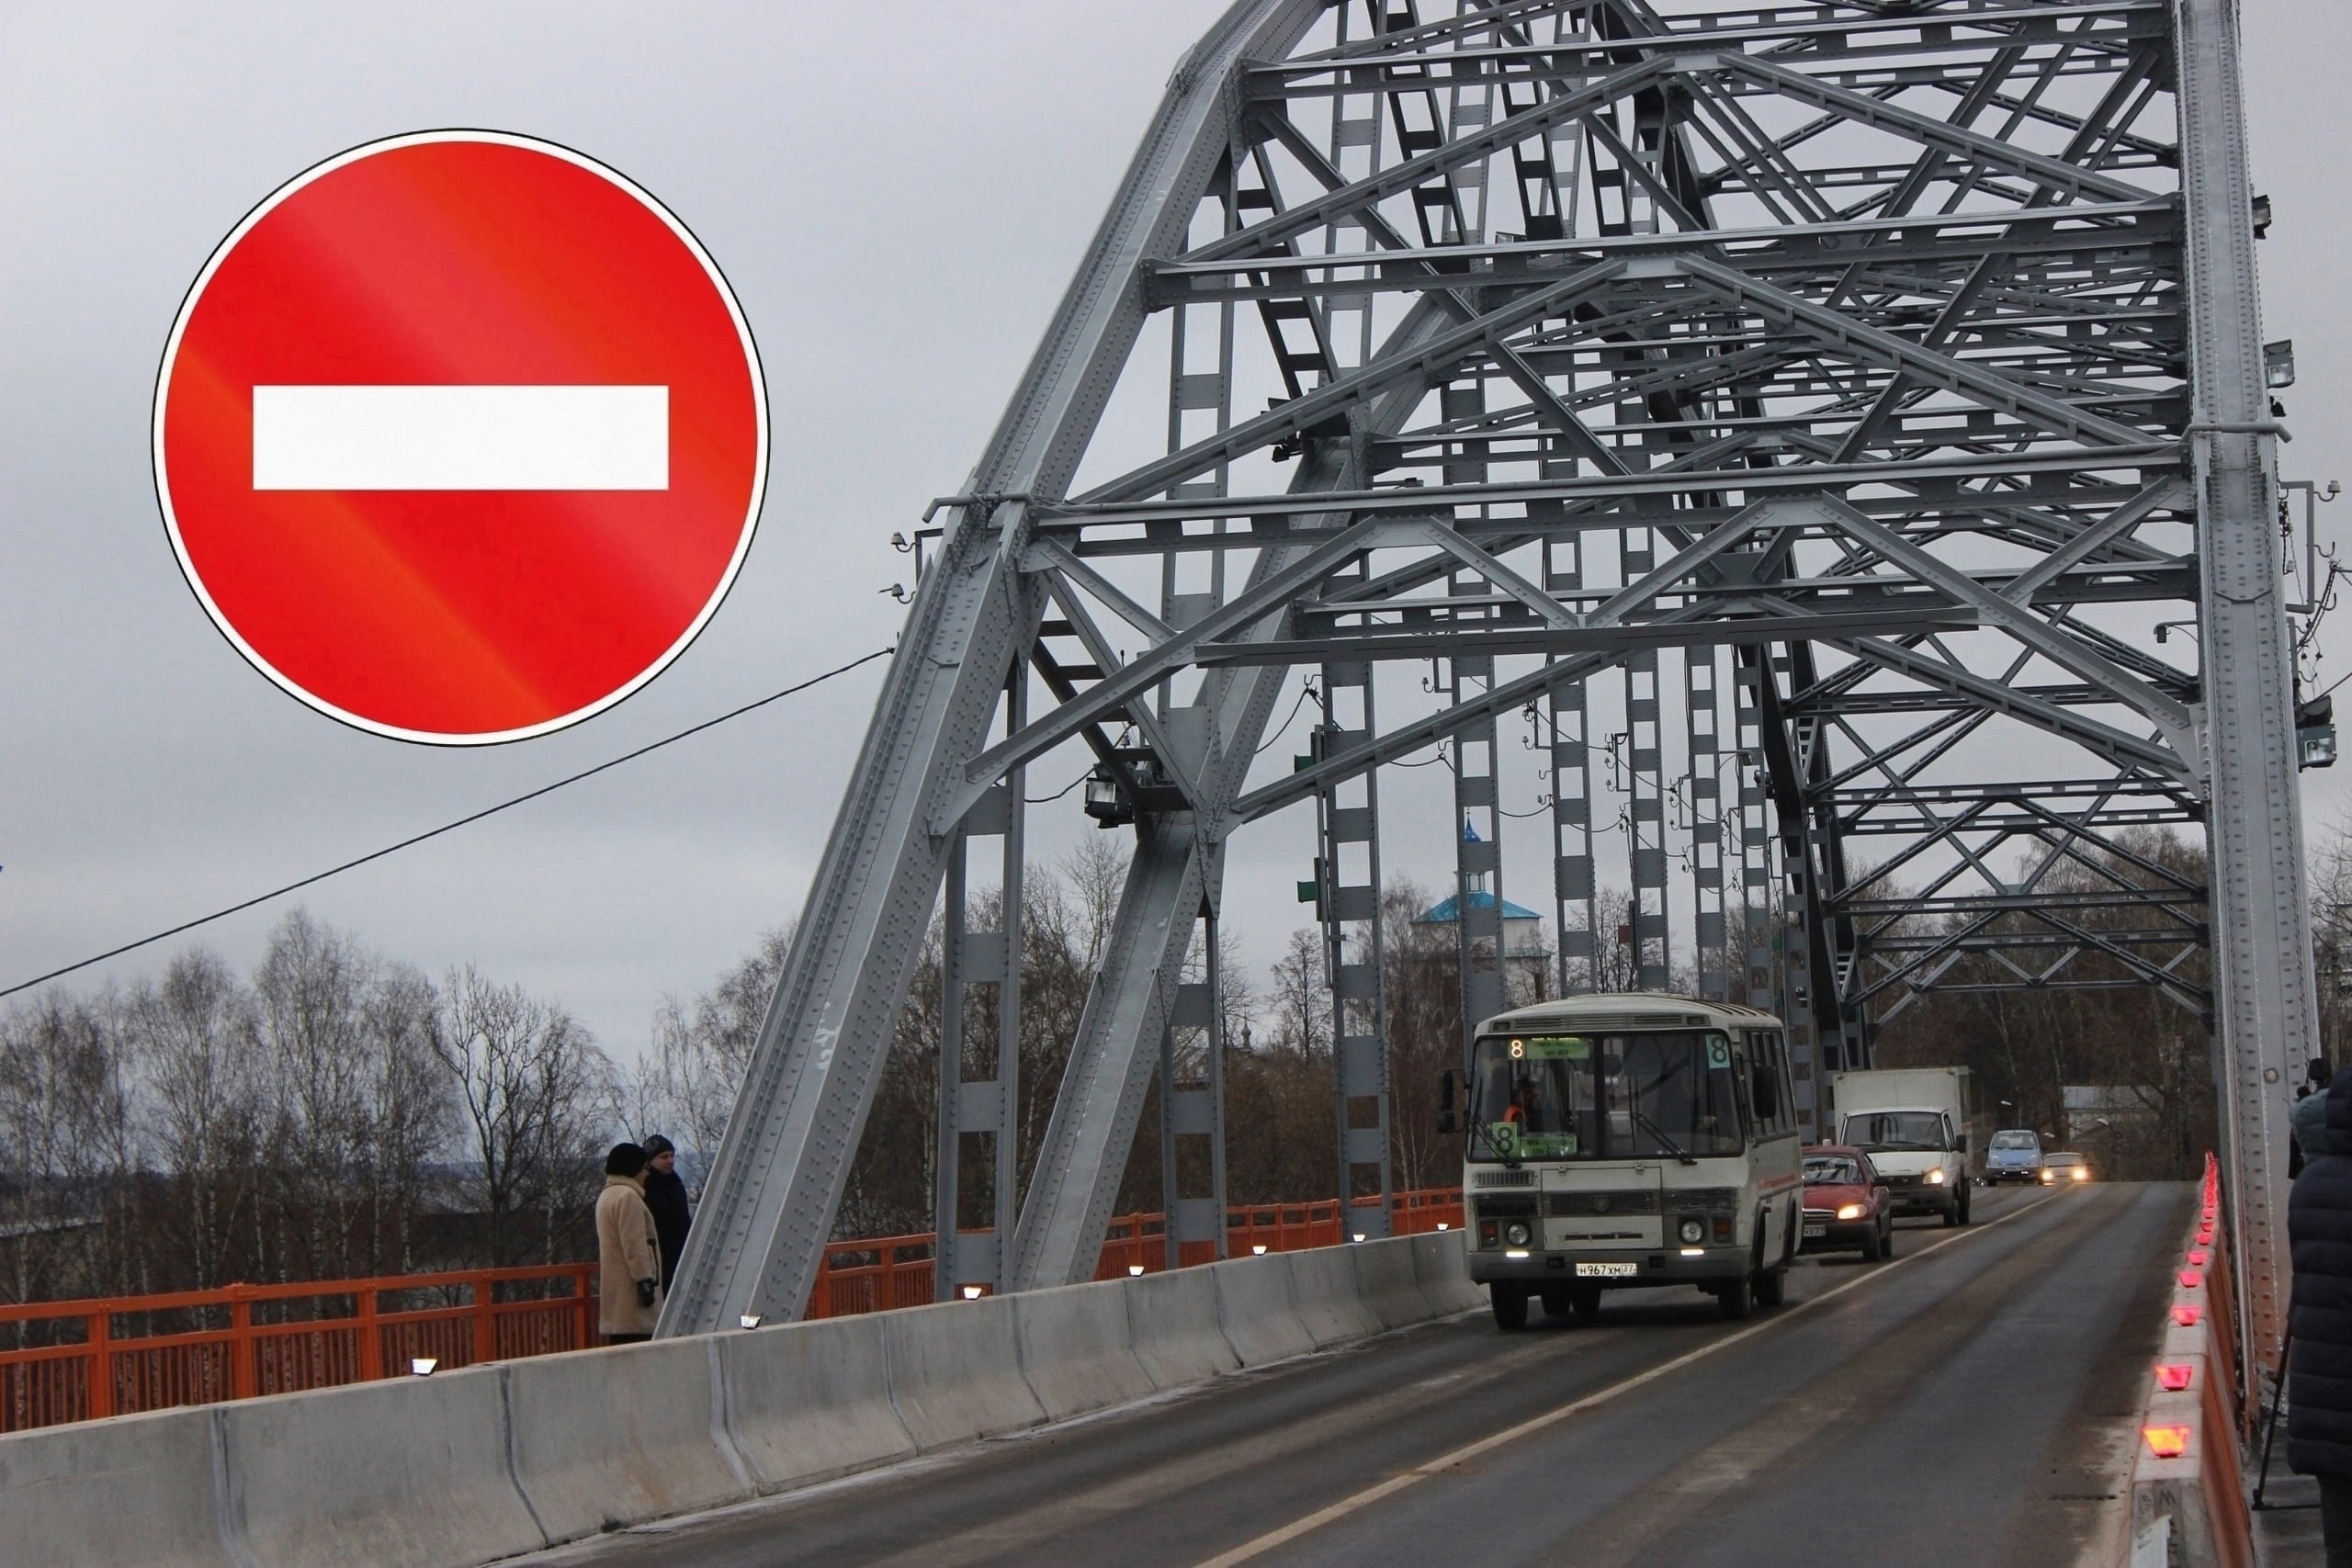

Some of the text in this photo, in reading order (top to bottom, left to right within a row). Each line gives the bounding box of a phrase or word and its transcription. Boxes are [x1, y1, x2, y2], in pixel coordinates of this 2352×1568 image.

[1511, 1040, 1522, 1057] 8
[1711, 1036, 1727, 1064] 8
[1498, 1126, 1513, 1154] 8
